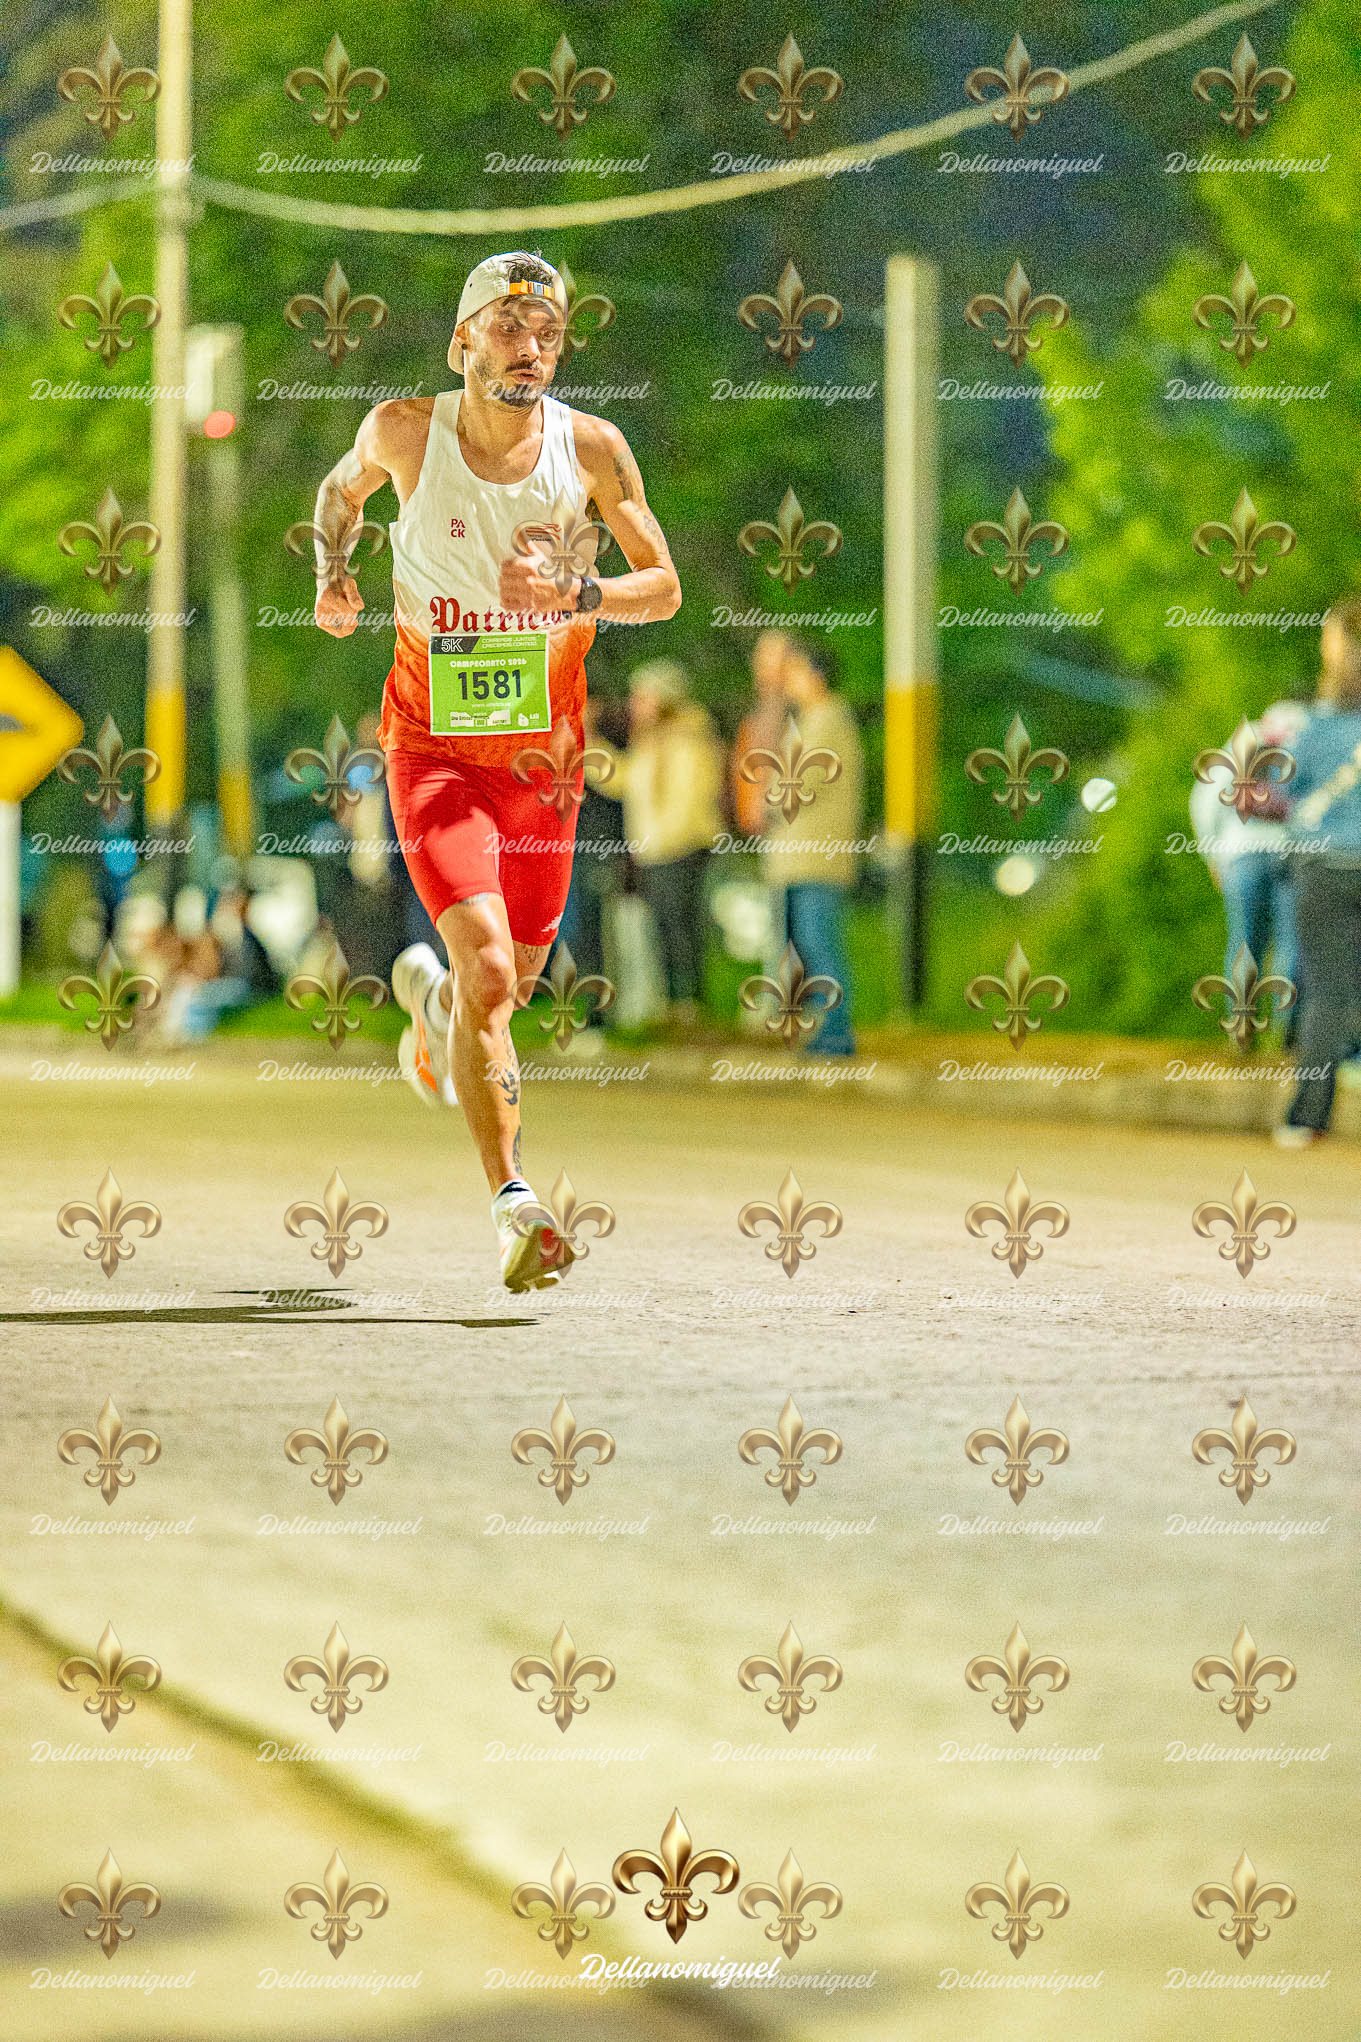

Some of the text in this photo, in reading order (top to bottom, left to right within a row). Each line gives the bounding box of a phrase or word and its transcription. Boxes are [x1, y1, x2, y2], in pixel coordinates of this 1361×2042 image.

[441, 638, 464, 653] 5K
[449, 659, 506, 668] CAMPEONATO
[457, 669, 523, 700] 1581
